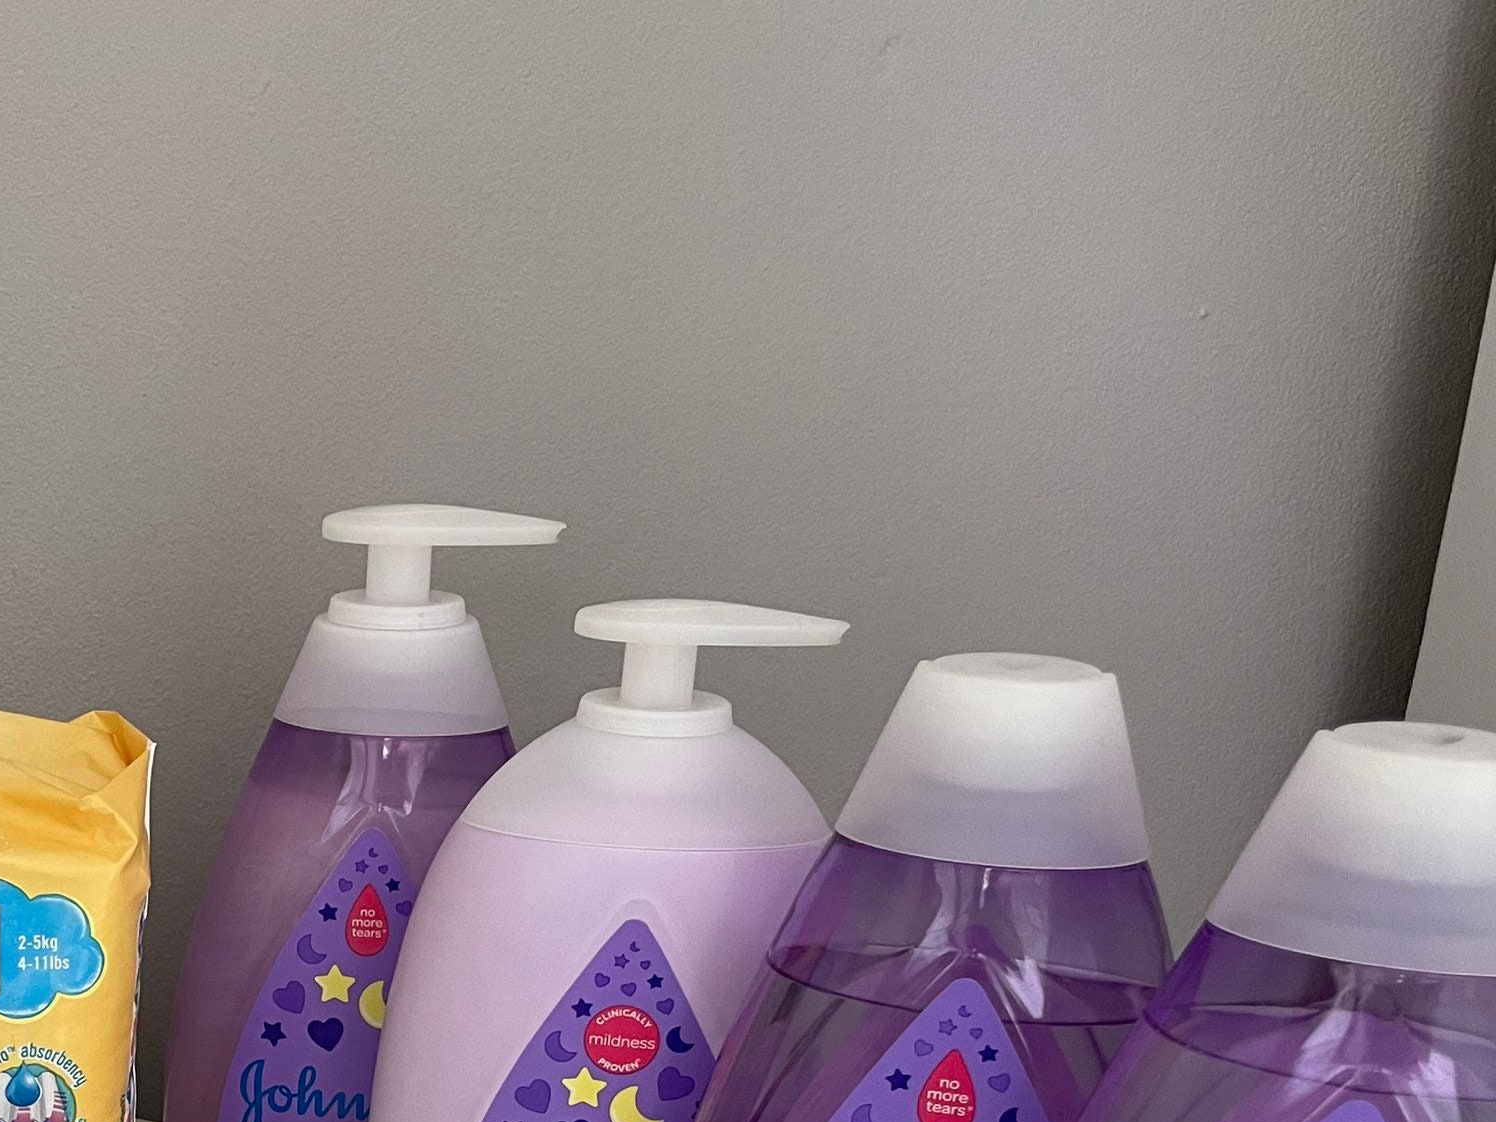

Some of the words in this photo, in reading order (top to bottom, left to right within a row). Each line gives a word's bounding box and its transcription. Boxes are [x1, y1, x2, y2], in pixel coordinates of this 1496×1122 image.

[360, 908, 376, 918] no
[351, 919, 383, 928] more
[18, 935, 59, 952] 2-5kg
[18, 954, 70, 971] 4-11lbs
[596, 1009, 653, 1028] CLINICALLY
[589, 1034, 656, 1050] mildness
[21, 1043, 87, 1088] absorbency
[939, 1079, 961, 1090] no
[926, 1090, 969, 1104] more
